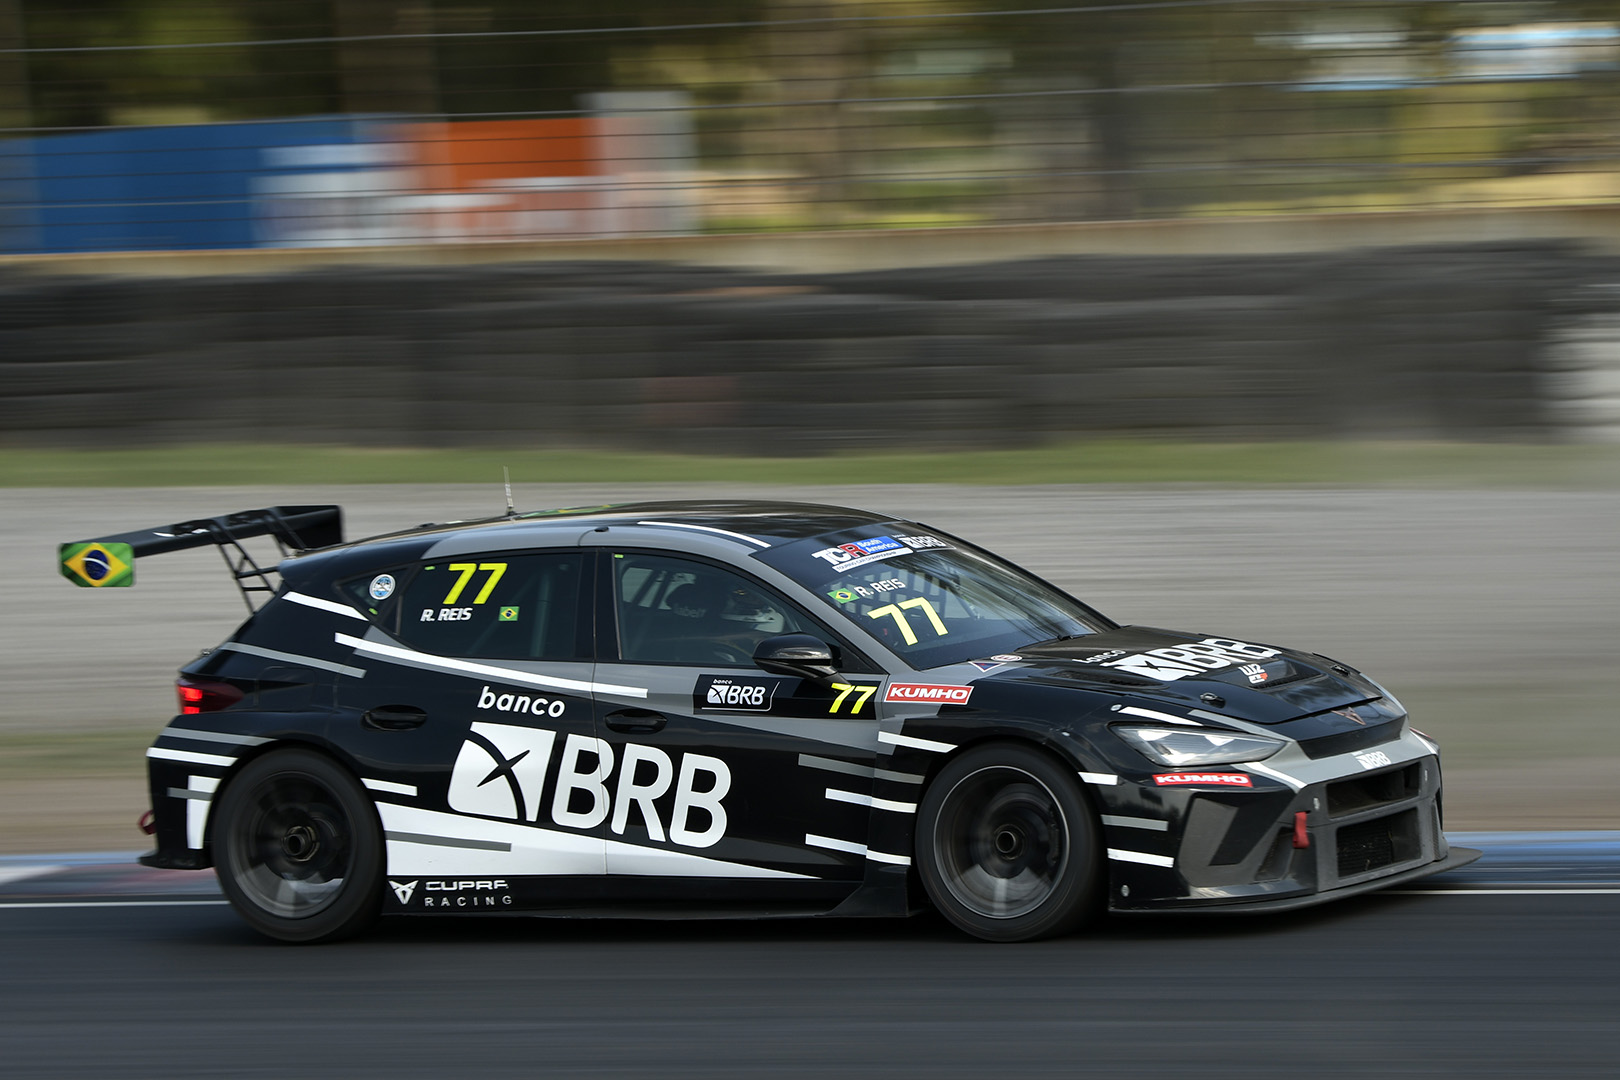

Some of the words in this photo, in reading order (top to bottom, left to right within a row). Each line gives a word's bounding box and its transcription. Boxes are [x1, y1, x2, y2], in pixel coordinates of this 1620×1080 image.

[856, 539, 883, 548] South
[865, 542, 899, 552] America
[812, 543, 868, 565] TCR
[442, 563, 508, 604] 77
[854, 586, 874, 598] R.
[870, 578, 906, 594] REIS
[420, 609, 435, 621] R.
[437, 608, 473, 621] REIS
[867, 596, 948, 646] 77
[1144, 638, 1283, 673] BRB
[477, 685, 566, 718] banco
[727, 685, 766, 705] BRB
[829, 682, 877, 715] 77
[889, 686, 969, 700] KUMHO
[1156, 774, 1249, 784] KUMHO
[551, 733, 732, 849] BRB
[424, 895, 512, 907] RACING
